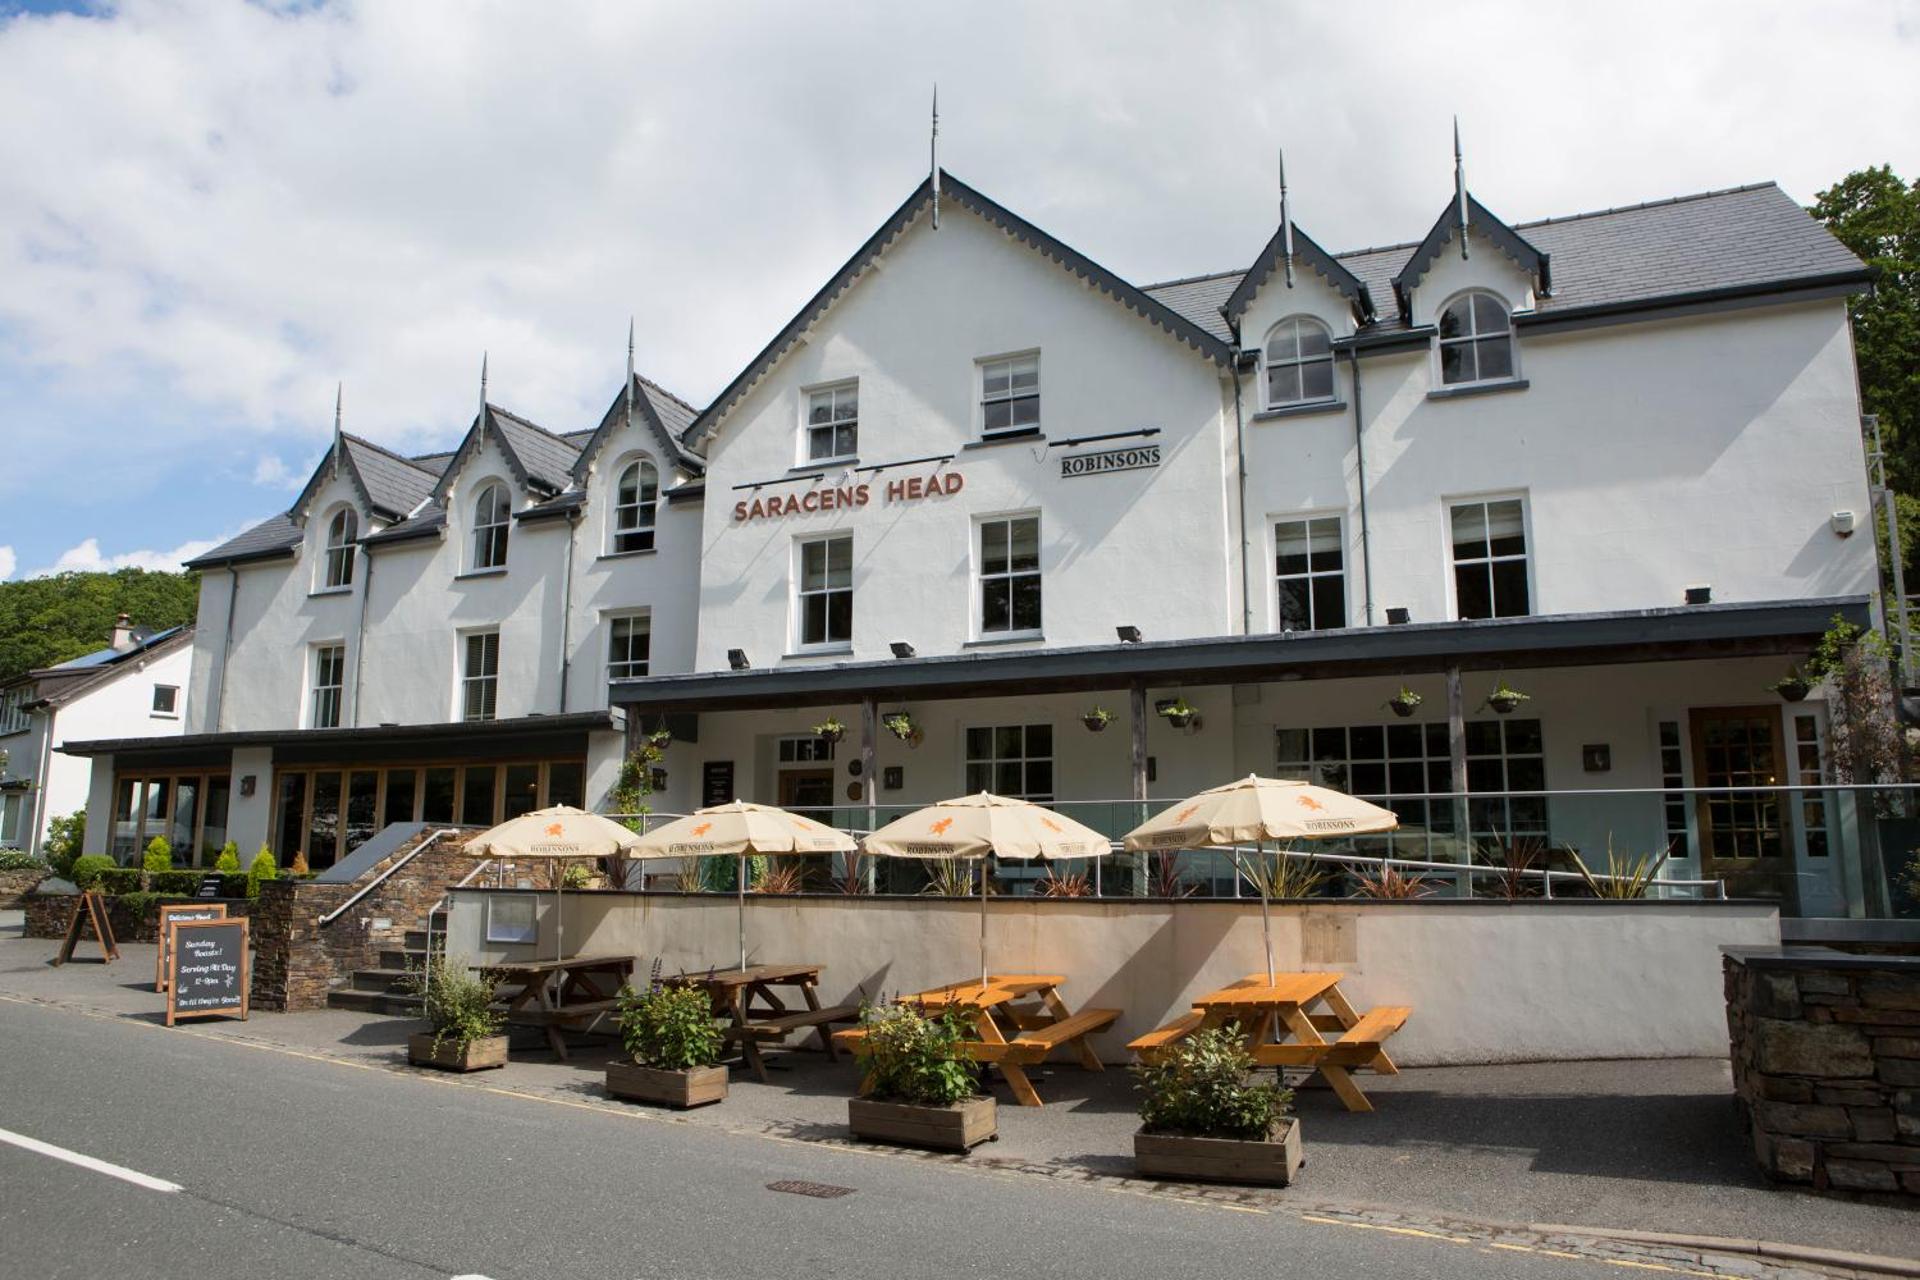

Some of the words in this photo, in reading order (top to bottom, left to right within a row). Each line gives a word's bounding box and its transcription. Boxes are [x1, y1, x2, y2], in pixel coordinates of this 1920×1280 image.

[1061, 448, 1161, 475] ROBINSONS
[734, 484, 869, 522] SARACENS
[888, 472, 964, 503] HEAD
[185, 940, 216, 949] Sunday
[181, 965, 209, 974] Serving
[221, 963, 236, 973] Day
